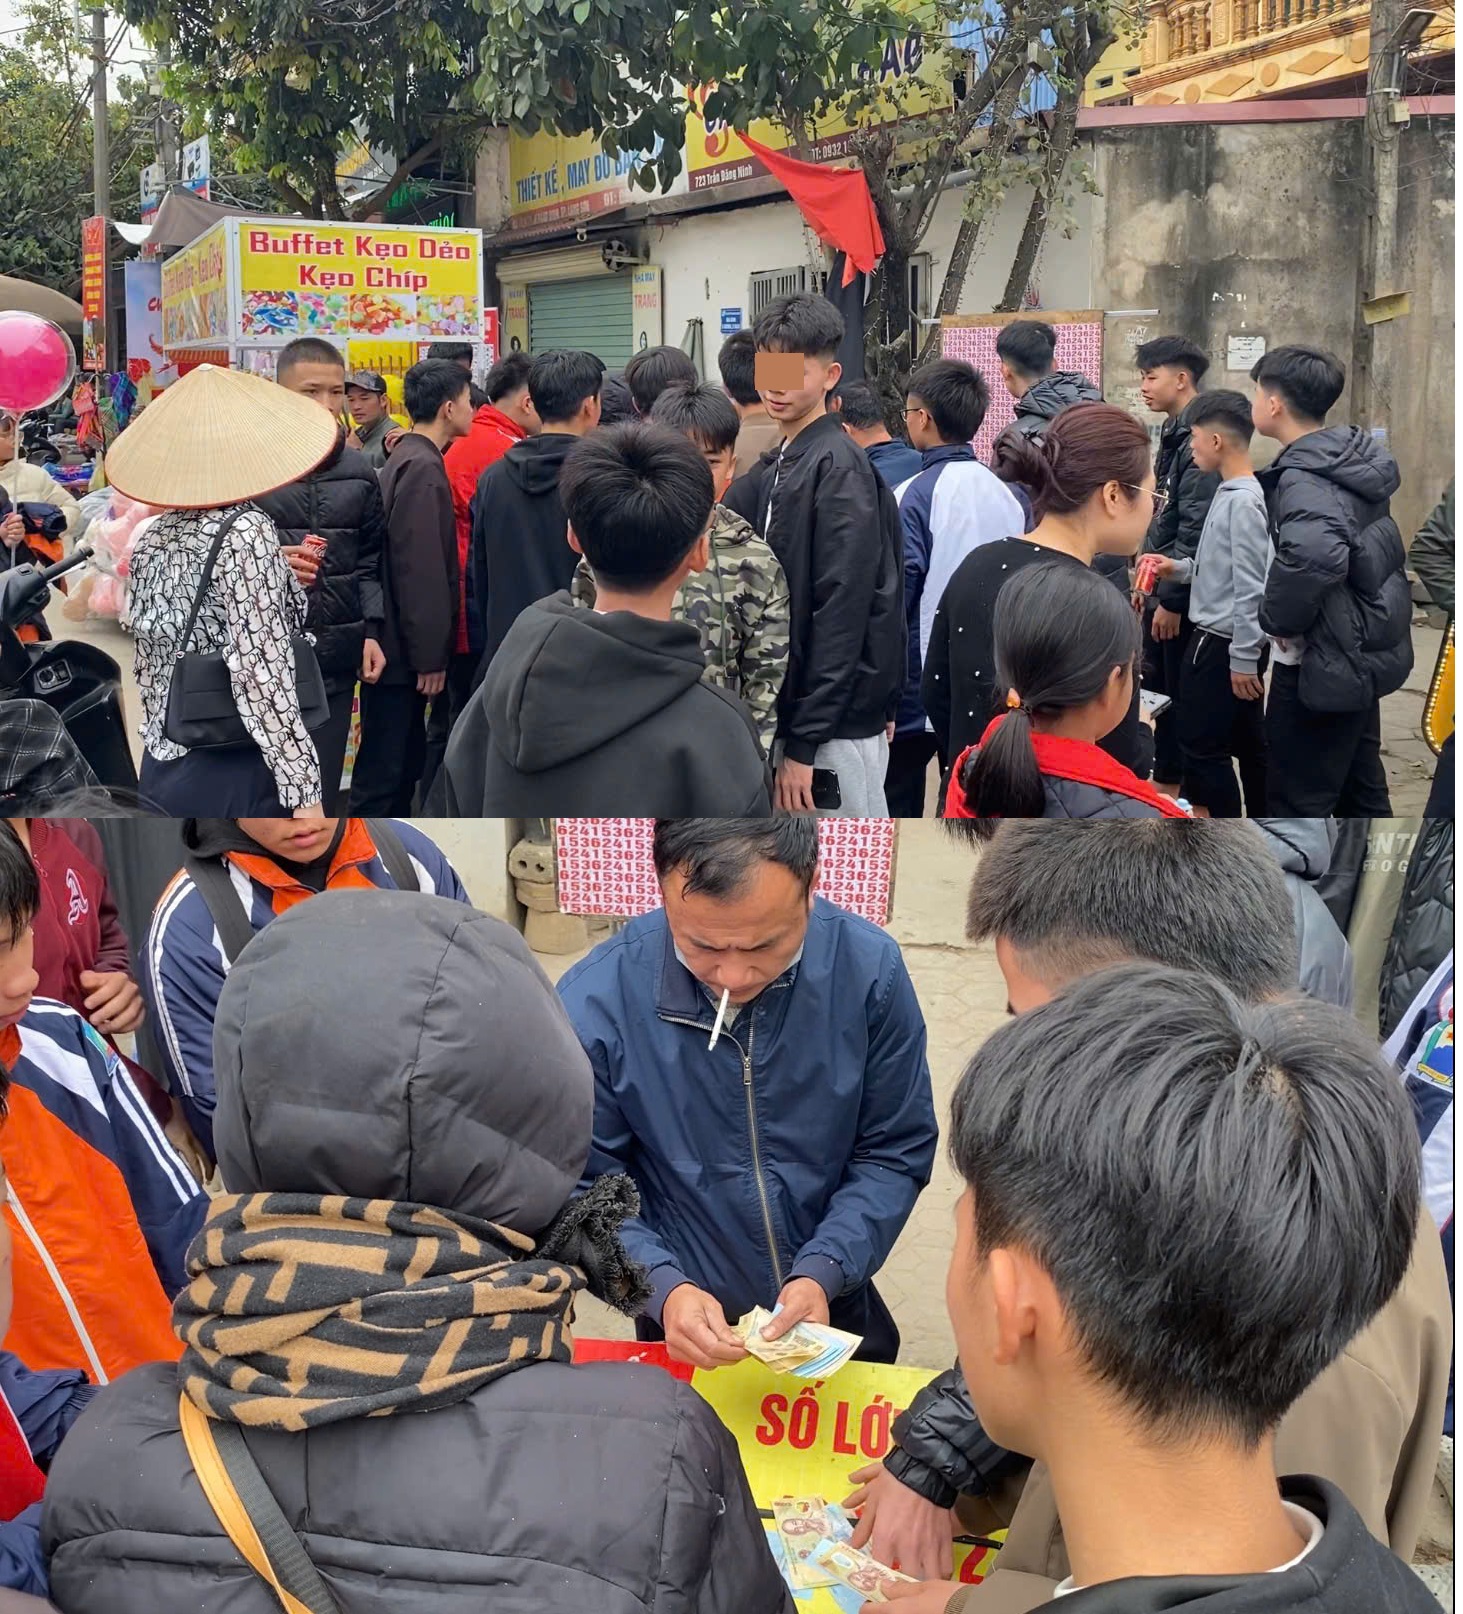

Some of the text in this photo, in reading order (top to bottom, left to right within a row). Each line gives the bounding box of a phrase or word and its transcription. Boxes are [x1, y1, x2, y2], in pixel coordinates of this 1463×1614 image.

[822, 142, 841, 158] 0932
[567, 157, 590, 189] MAY
[695, 174, 706, 188] 723
[737, 164, 753, 178] Ninh
[250, 231, 470, 260] Buffet Kẹo Dẻo
[300, 265, 428, 292] Kẹo Chíp
[634, 294, 657, 308] TRANG
[820, 847, 891, 859] 153624
[560, 859, 656, 873] 153624153
[560, 870, 889, 884] 624153624 153624
[561, 892, 663, 906] 624153624
[755, 1381, 905, 1459] SỐ LỚ
